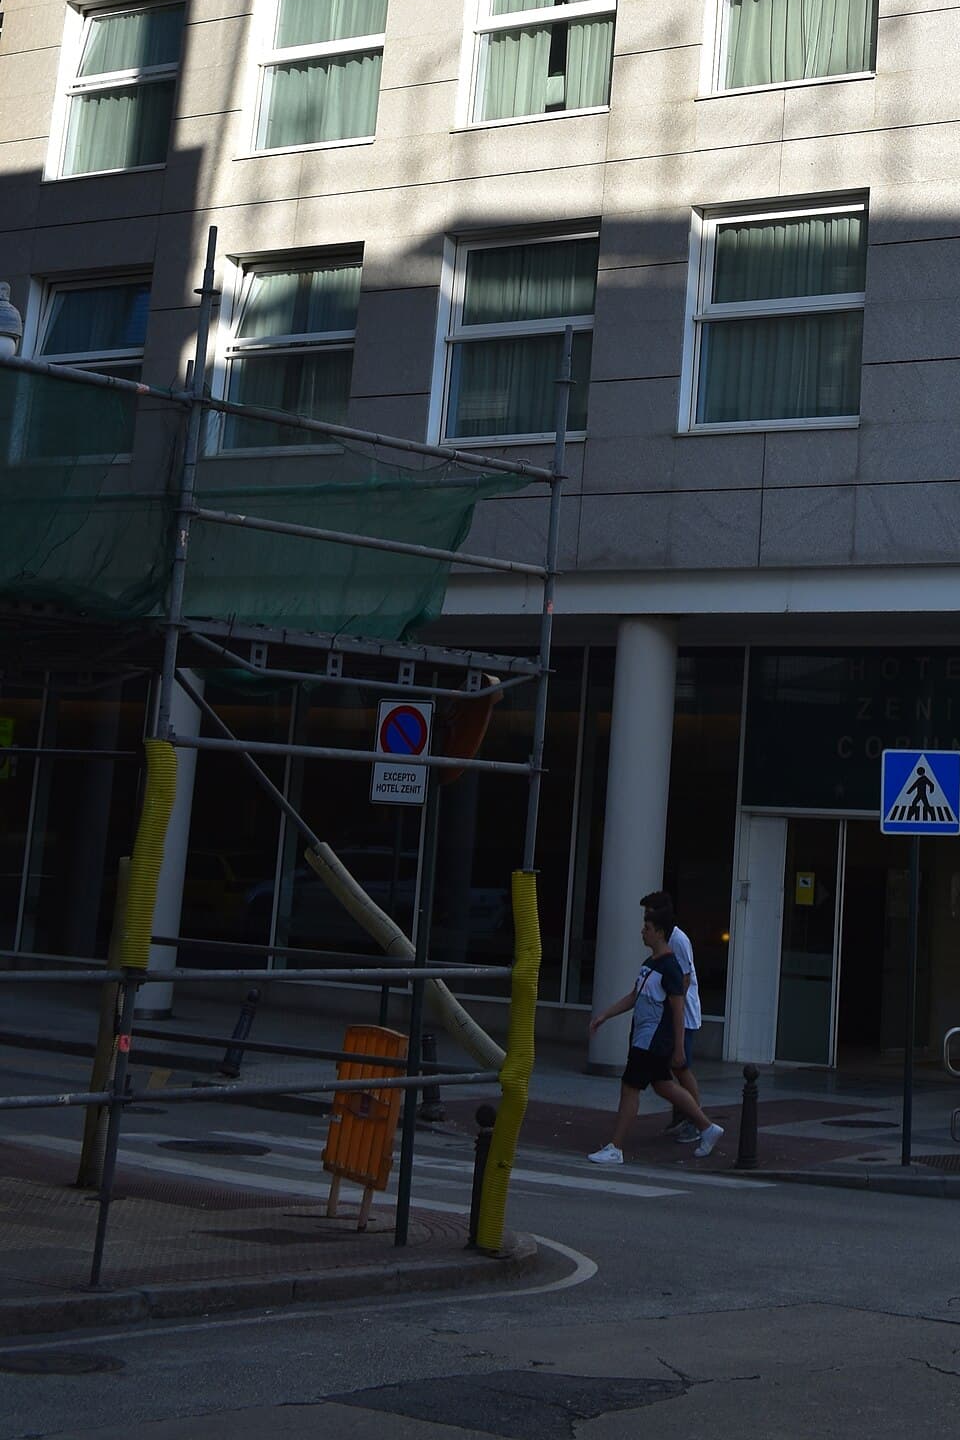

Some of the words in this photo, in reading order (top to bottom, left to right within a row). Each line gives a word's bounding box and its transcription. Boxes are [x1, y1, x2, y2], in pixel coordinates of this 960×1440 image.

[383, 771, 416, 782] EXCEPTO
[376, 783, 399, 793] HOTEL
[400, 784, 421, 794] ZENIT
